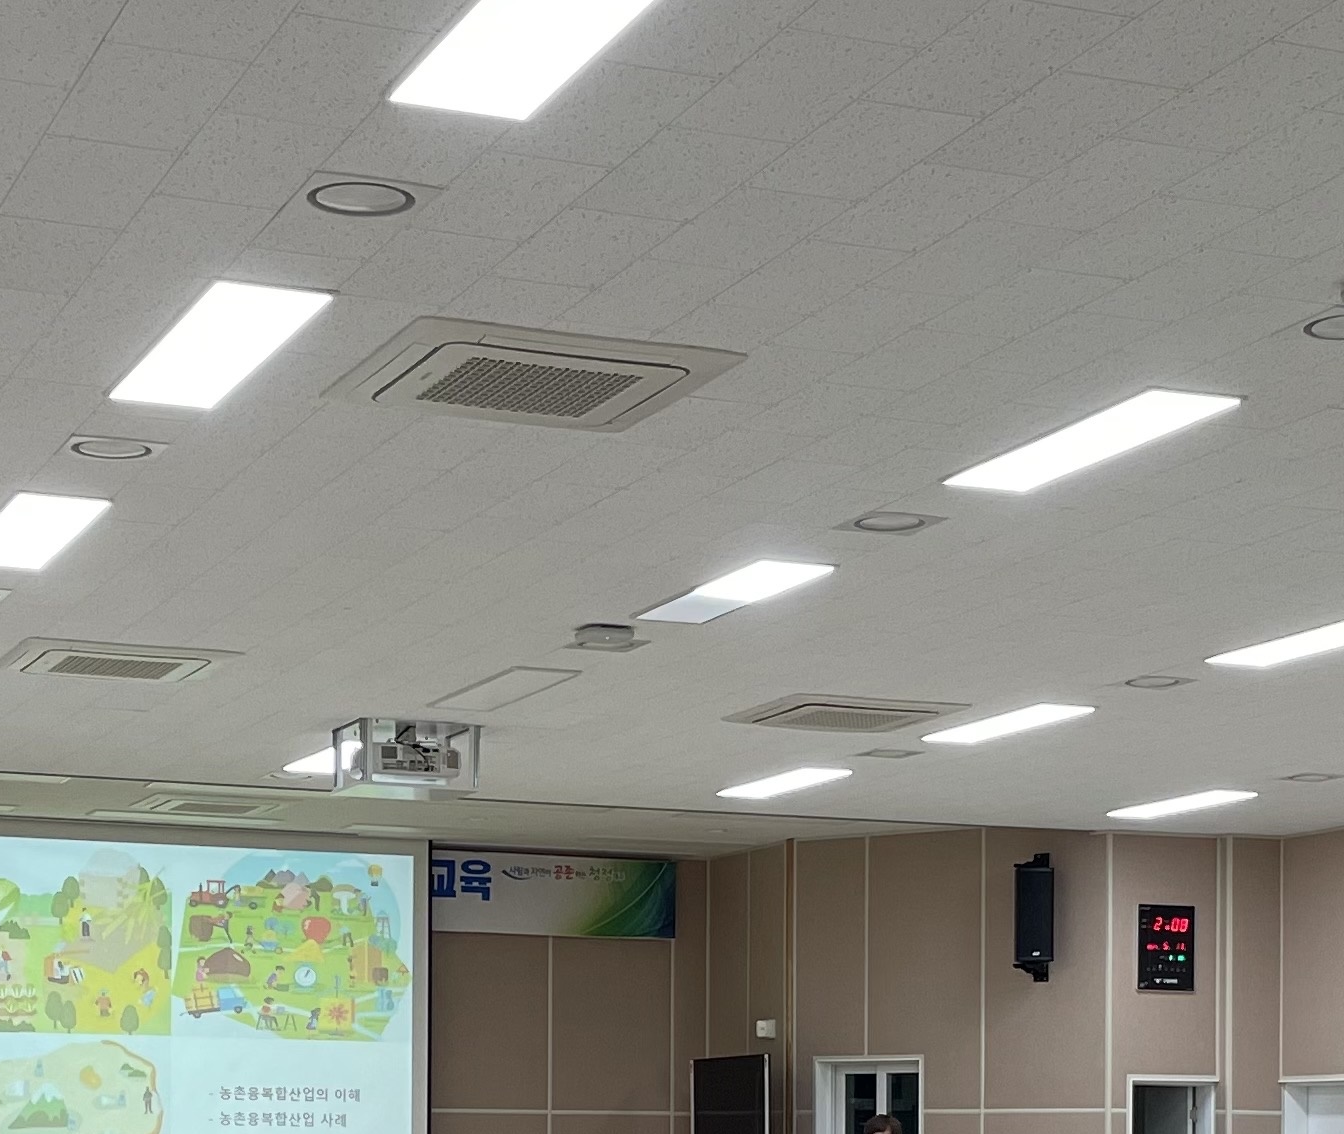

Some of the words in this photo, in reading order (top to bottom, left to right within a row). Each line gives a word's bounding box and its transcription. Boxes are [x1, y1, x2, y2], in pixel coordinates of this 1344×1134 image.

[219, 1085, 328, 1102] 농촌융복합산업의
[334, 1088, 361, 1103] 이해
[219, 1111, 315, 1128] 농촌융복합산업
[320, 1113, 347, 1128] 사례
